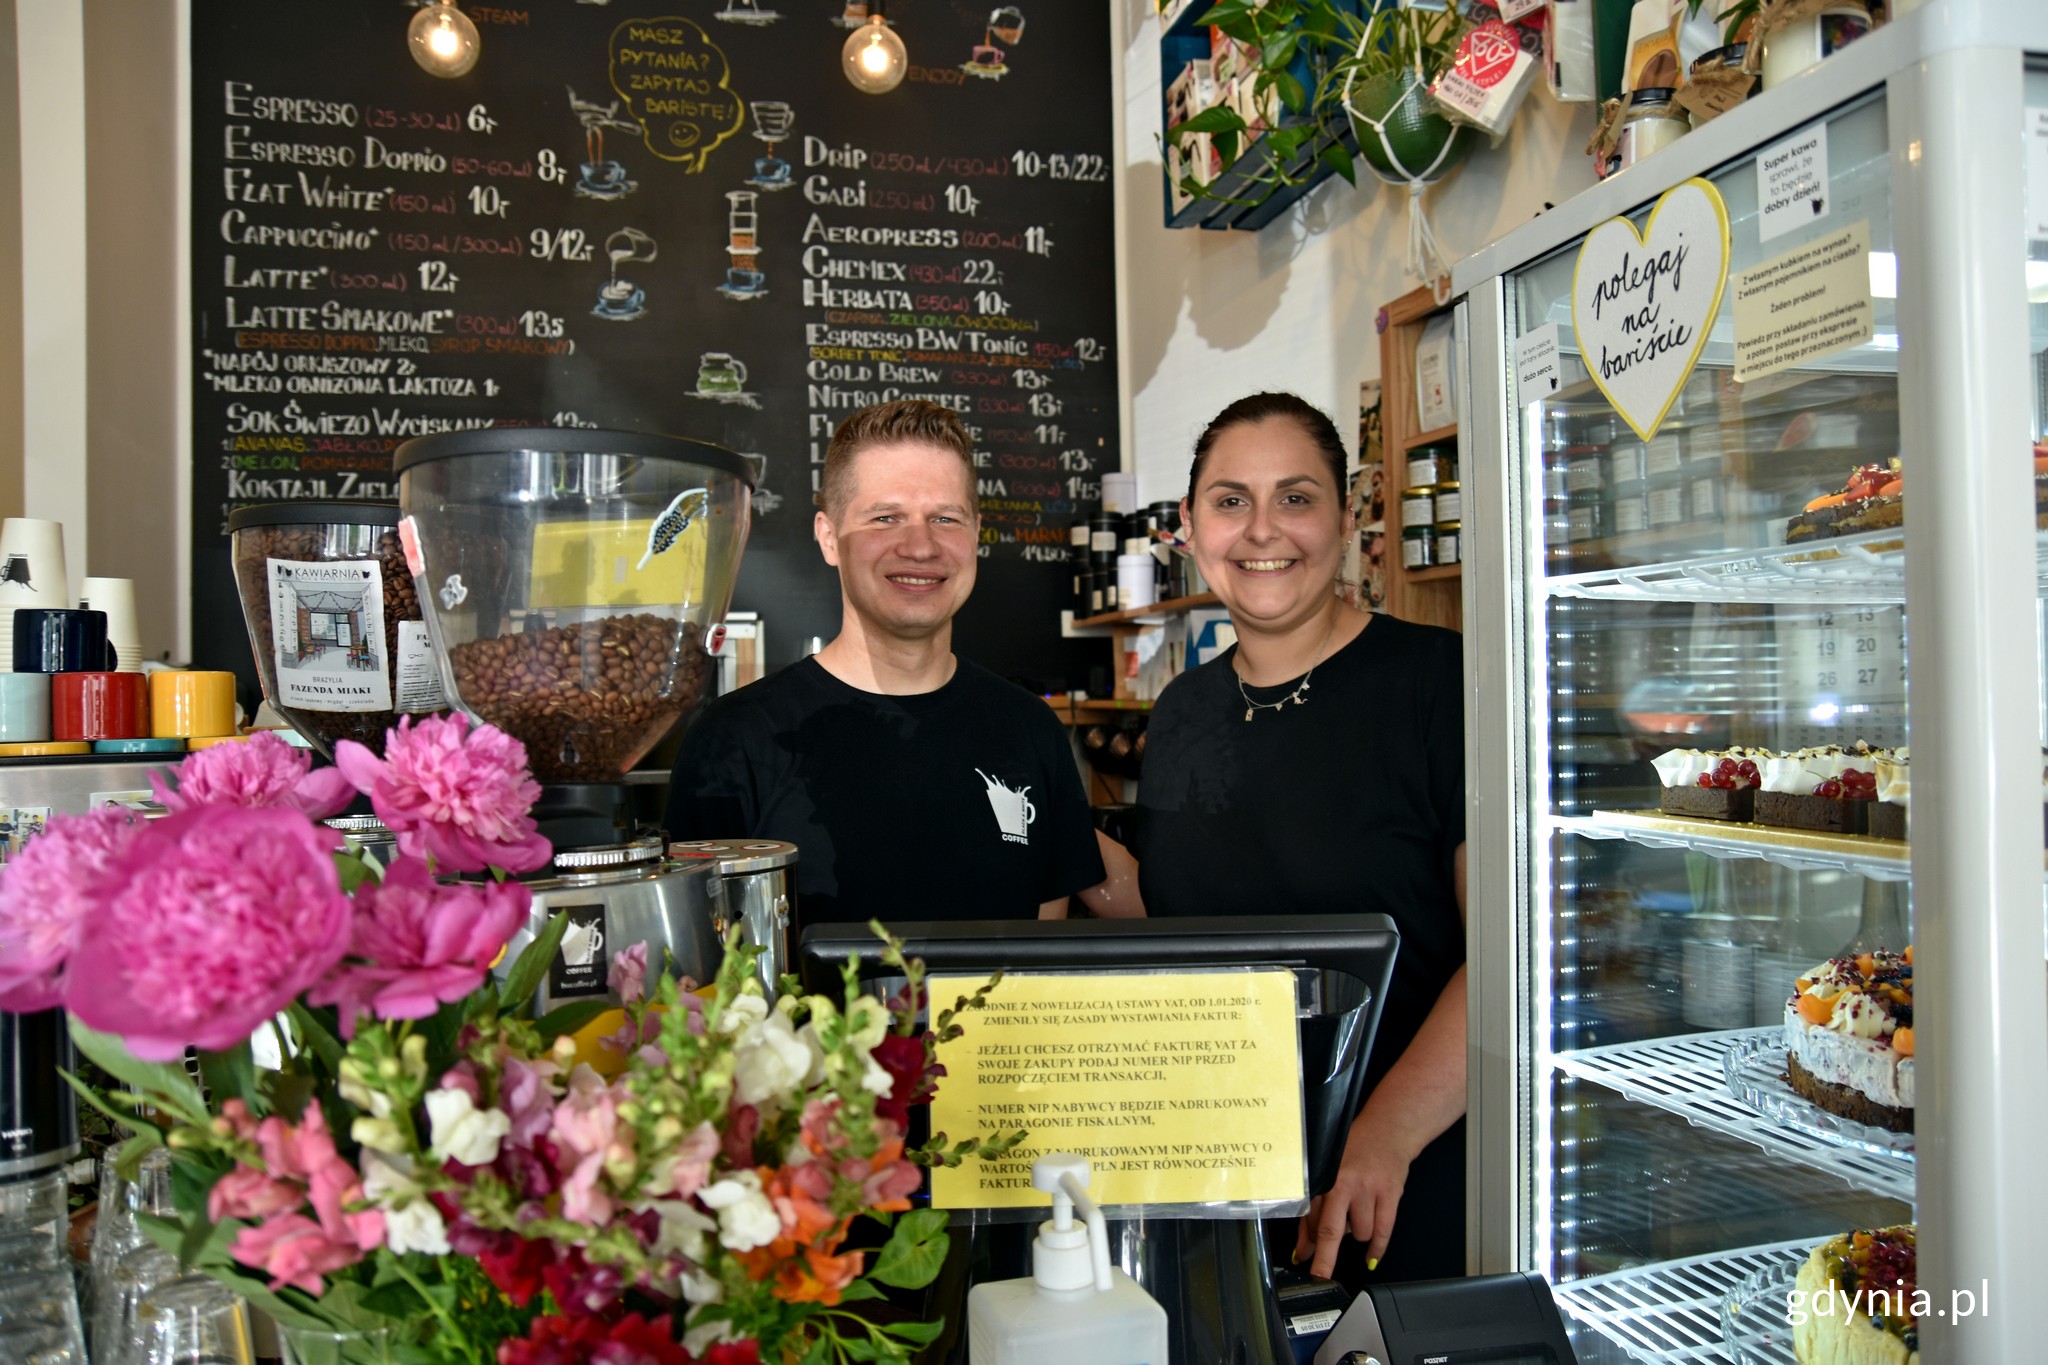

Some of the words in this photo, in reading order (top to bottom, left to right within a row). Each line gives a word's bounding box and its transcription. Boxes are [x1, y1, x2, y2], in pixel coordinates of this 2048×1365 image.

[629, 27, 683, 45] MASZ
[630, 74, 711, 95] ZAPYTAJ
[224, 81, 358, 127] ESPRESSO
[224, 125, 355, 167] ESPRESSO
[364, 135, 447, 173] DOPPIO
[804, 135, 867, 170] DRIP
[1764, 153, 1789, 171] Super
[1791, 139, 1817, 157] kawa
[224, 167, 293, 203] FLAT
[803, 174, 866, 206] GABI
[1764, 196, 1790, 214] dobry
[1793, 181, 1820, 201] dzień!
[802, 212, 959, 248] AEROPRESS
[802, 245, 906, 282] CHEMEX
[1743, 280, 1774, 298] własnym
[1775, 263, 1821, 289] pojemnikiem
[1822, 258, 1832, 268] na
[1833, 244, 1860, 263] ciasto?
[1748, 265, 1779, 282] własnym
[1780, 253, 1811, 270] kubkiem
[1812, 248, 1821, 256] na
[1822, 234, 1851, 254] wynos?
[1592, 233, 1689, 320] polegaj
[802, 279, 913, 311] HERBATA
[1770, 298, 1792, 314] Żaden
[1793, 285, 1826, 307] problem!
[226, 297, 316, 330] LATTE
[1621, 304, 1660, 335] na
[806, 323, 914, 349] ESPRESSO
[916, 327, 963, 351] BW
[964, 331, 1029, 356] TONIC
[1737, 334, 1765, 350] Powiedz
[1767, 328, 1784, 344] przy
[1783, 316, 1817, 335] składaniu
[1751, 346, 1773, 361] potem
[1775, 337, 1801, 353] postaw
[1801, 330, 1818, 344] przy
[1819, 317, 1857, 338] ekspresie
[1600, 319, 1692, 380] bariście
[1740, 367, 1746, 375] w
[1746, 358, 1773, 374] miejscu
[1774, 354, 1783, 364] do
[1783, 350, 1800, 363] tego
[1800, 329, 1861, 356] przeznaczonym
[806, 360, 872, 381] COLD
[879, 362, 943, 384] BREW
[388, 376, 477, 397] LAKTOZA
[808, 385, 878, 409] NITRO
[226, 401, 281, 434] SOK
[228, 470, 333, 498] KOKTAJL
[295, 568, 360, 579] KAWIARNIA
[1856, 638, 1876, 653] 20
[291, 684, 333, 694] FAZENDA
[313, 676, 343, 684] BRAZYLIA
[1818, 672, 1837, 686] 26
[1858, 668, 1878, 683] 27
[1002, 834, 1029, 845] COFFEE
[566, 966, 593, 975] COFFEE
[1020, 1002, 1028, 1010] Z
[1031, 1000, 1114, 1011] NOWELIZACJĄ
[1117, 999, 1161, 1009] USTAWY
[1190, 998, 1206, 1007] OD
[1209, 997, 1252, 1006] 1.01.2020
[983, 1016, 1040, 1025] ZMIENIŁY
[1043, 1015, 1060, 1026] SIĘ
[1063, 1014, 1107, 1024] ZASADY
[1111, 1012, 1191, 1022] WYSTAWIANIA
[1194, 1011, 1242, 1021] FAKTUR:
[977, 1043, 1020, 1055] JEŻELI
[1024, 1044, 1074, 1054] CHCESZ
[1077, 1040, 1150, 1054] OTRZYMAĆ
[1154, 1041, 1211, 1052] FAKTURĘ
[1215, 1040, 1238, 1050] VAT
[1240, 1039, 1257, 1049] ZA
[977, 1059, 1020, 1069] SWOJE
[1024, 1058, 1075, 1069] ZAKUPY
[1079, 1057, 1119, 1067] PODAJ
[1123, 1056, 1168, 1066] NUMER
[1172, 1055, 1193, 1065] NIP
[1195, 1054, 1236, 1064] PRZED
[978, 1072, 1080, 1085] ROZPOCZĘCIEM
[978, 1104, 1025, 1114] NUMER
[1028, 1103, 1049, 1113] NIP
[1052, 1102, 1117, 1112] NABYWCY
[1120, 1100, 1165, 1113] BĘDZIE
[1169, 1098, 1269, 1110] NADRUKOWANY
[978, 1119, 996, 1129] NA
[1000, 1117, 1073, 1128] PARAGONIE
[1077, 1115, 1155, 1127] FISKALNYM,
[1172, 1144, 1193, 1155] NIP
[1195, 1143, 1260, 1154] NABYWCY
[1262, 1142, 1272, 1152] O
[979, 1160, 1033, 1174] WARTOŚ
[1093, 1161, 1117, 1171] PLN
[1120, 1160, 1150, 1171] JEST
[1153, 1155, 1257, 1170] RÓWNOCZEŚNIE
[980, 1177, 1033, 1188] FAKTUR
[1424, 1356, 1448, 1364] POSNET
